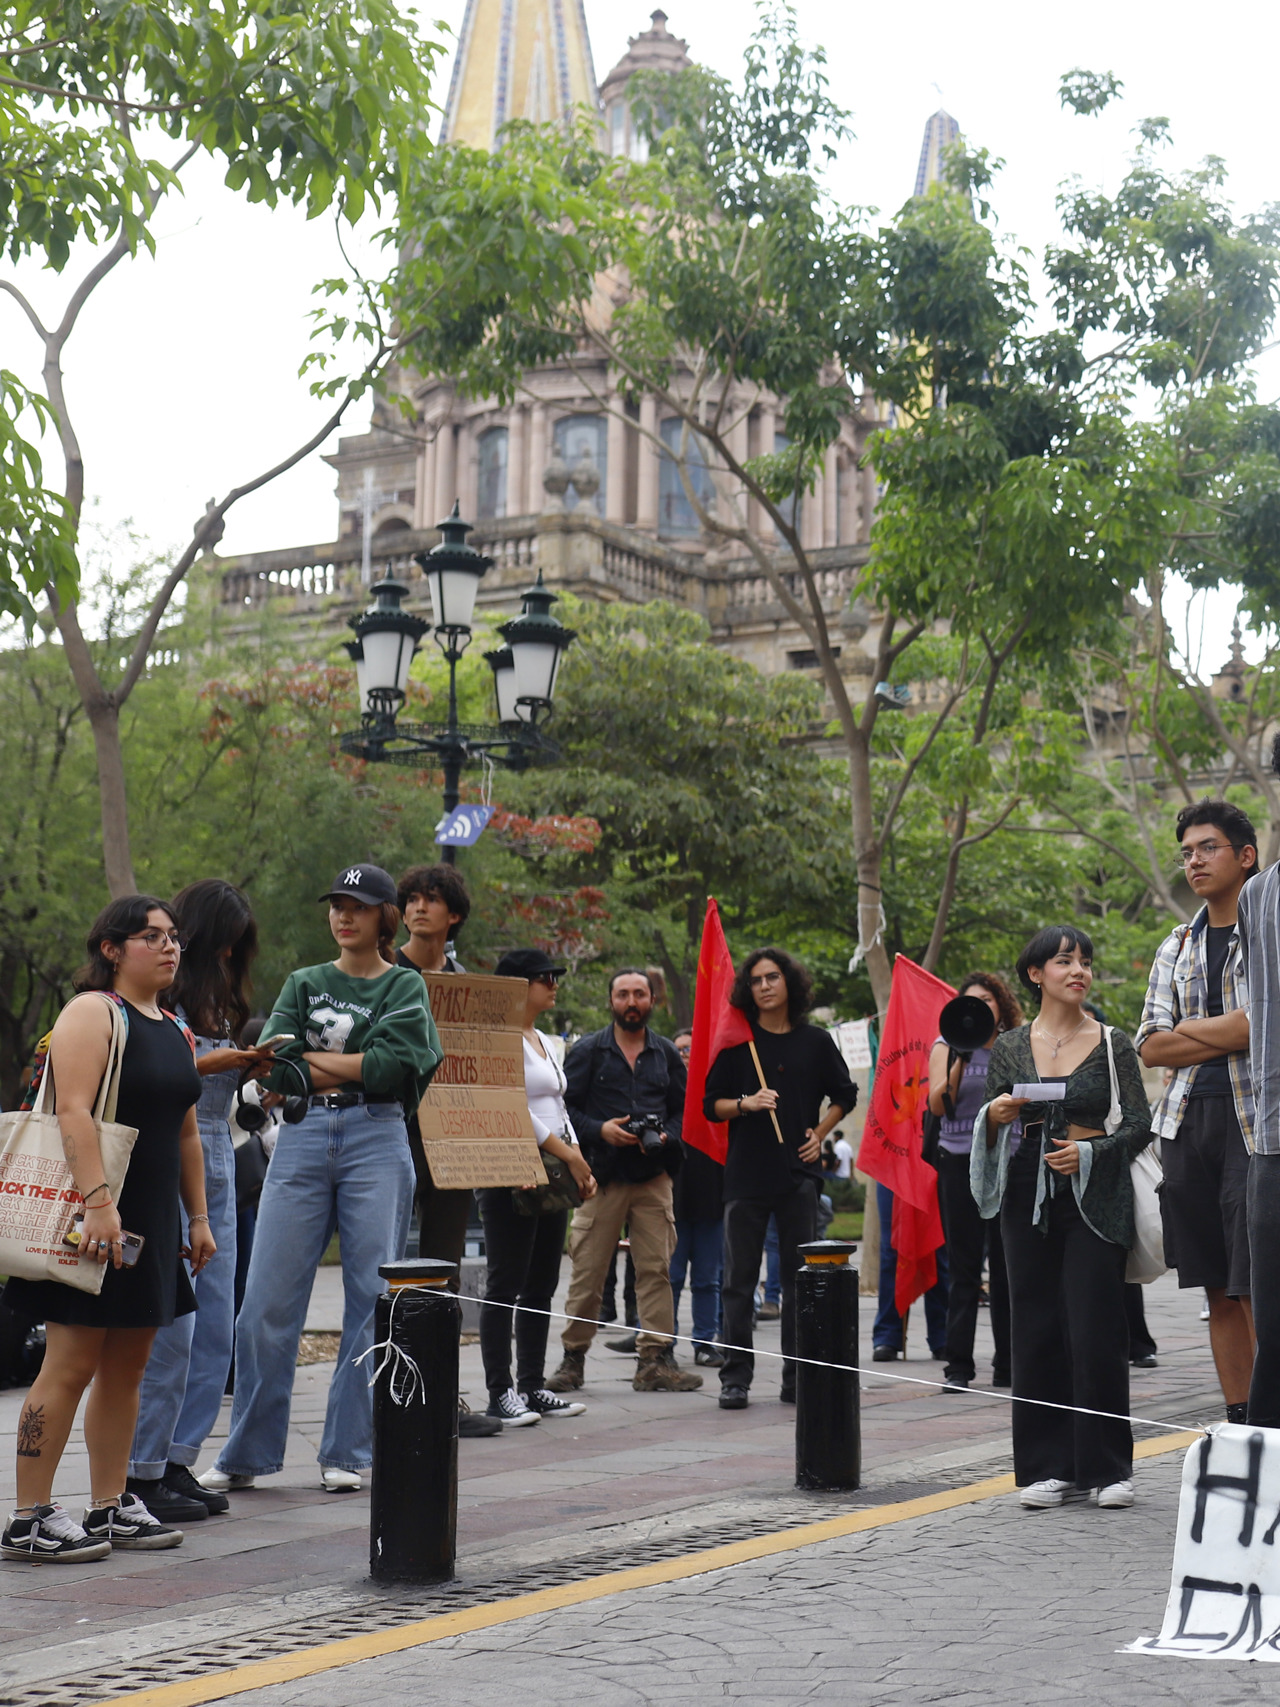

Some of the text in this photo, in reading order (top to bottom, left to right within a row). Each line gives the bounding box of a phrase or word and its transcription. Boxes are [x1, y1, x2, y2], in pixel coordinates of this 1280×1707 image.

[439, 1109, 523, 1139] DESAPARECIENDO
[1, 1152, 68, 1174] FUCK THE
[32, 1171, 63, 1188] THE
[0, 1181, 85, 1204] UCK THE KIN
[20, 1199, 54, 1215] THE
[18, 1212, 49, 1229] THE
[14, 1227, 44, 1242] THE
[26, 1246, 42, 1254] LOVE
[49, 1249, 63, 1257] THE
[58, 1259, 79, 1267] IDLES
